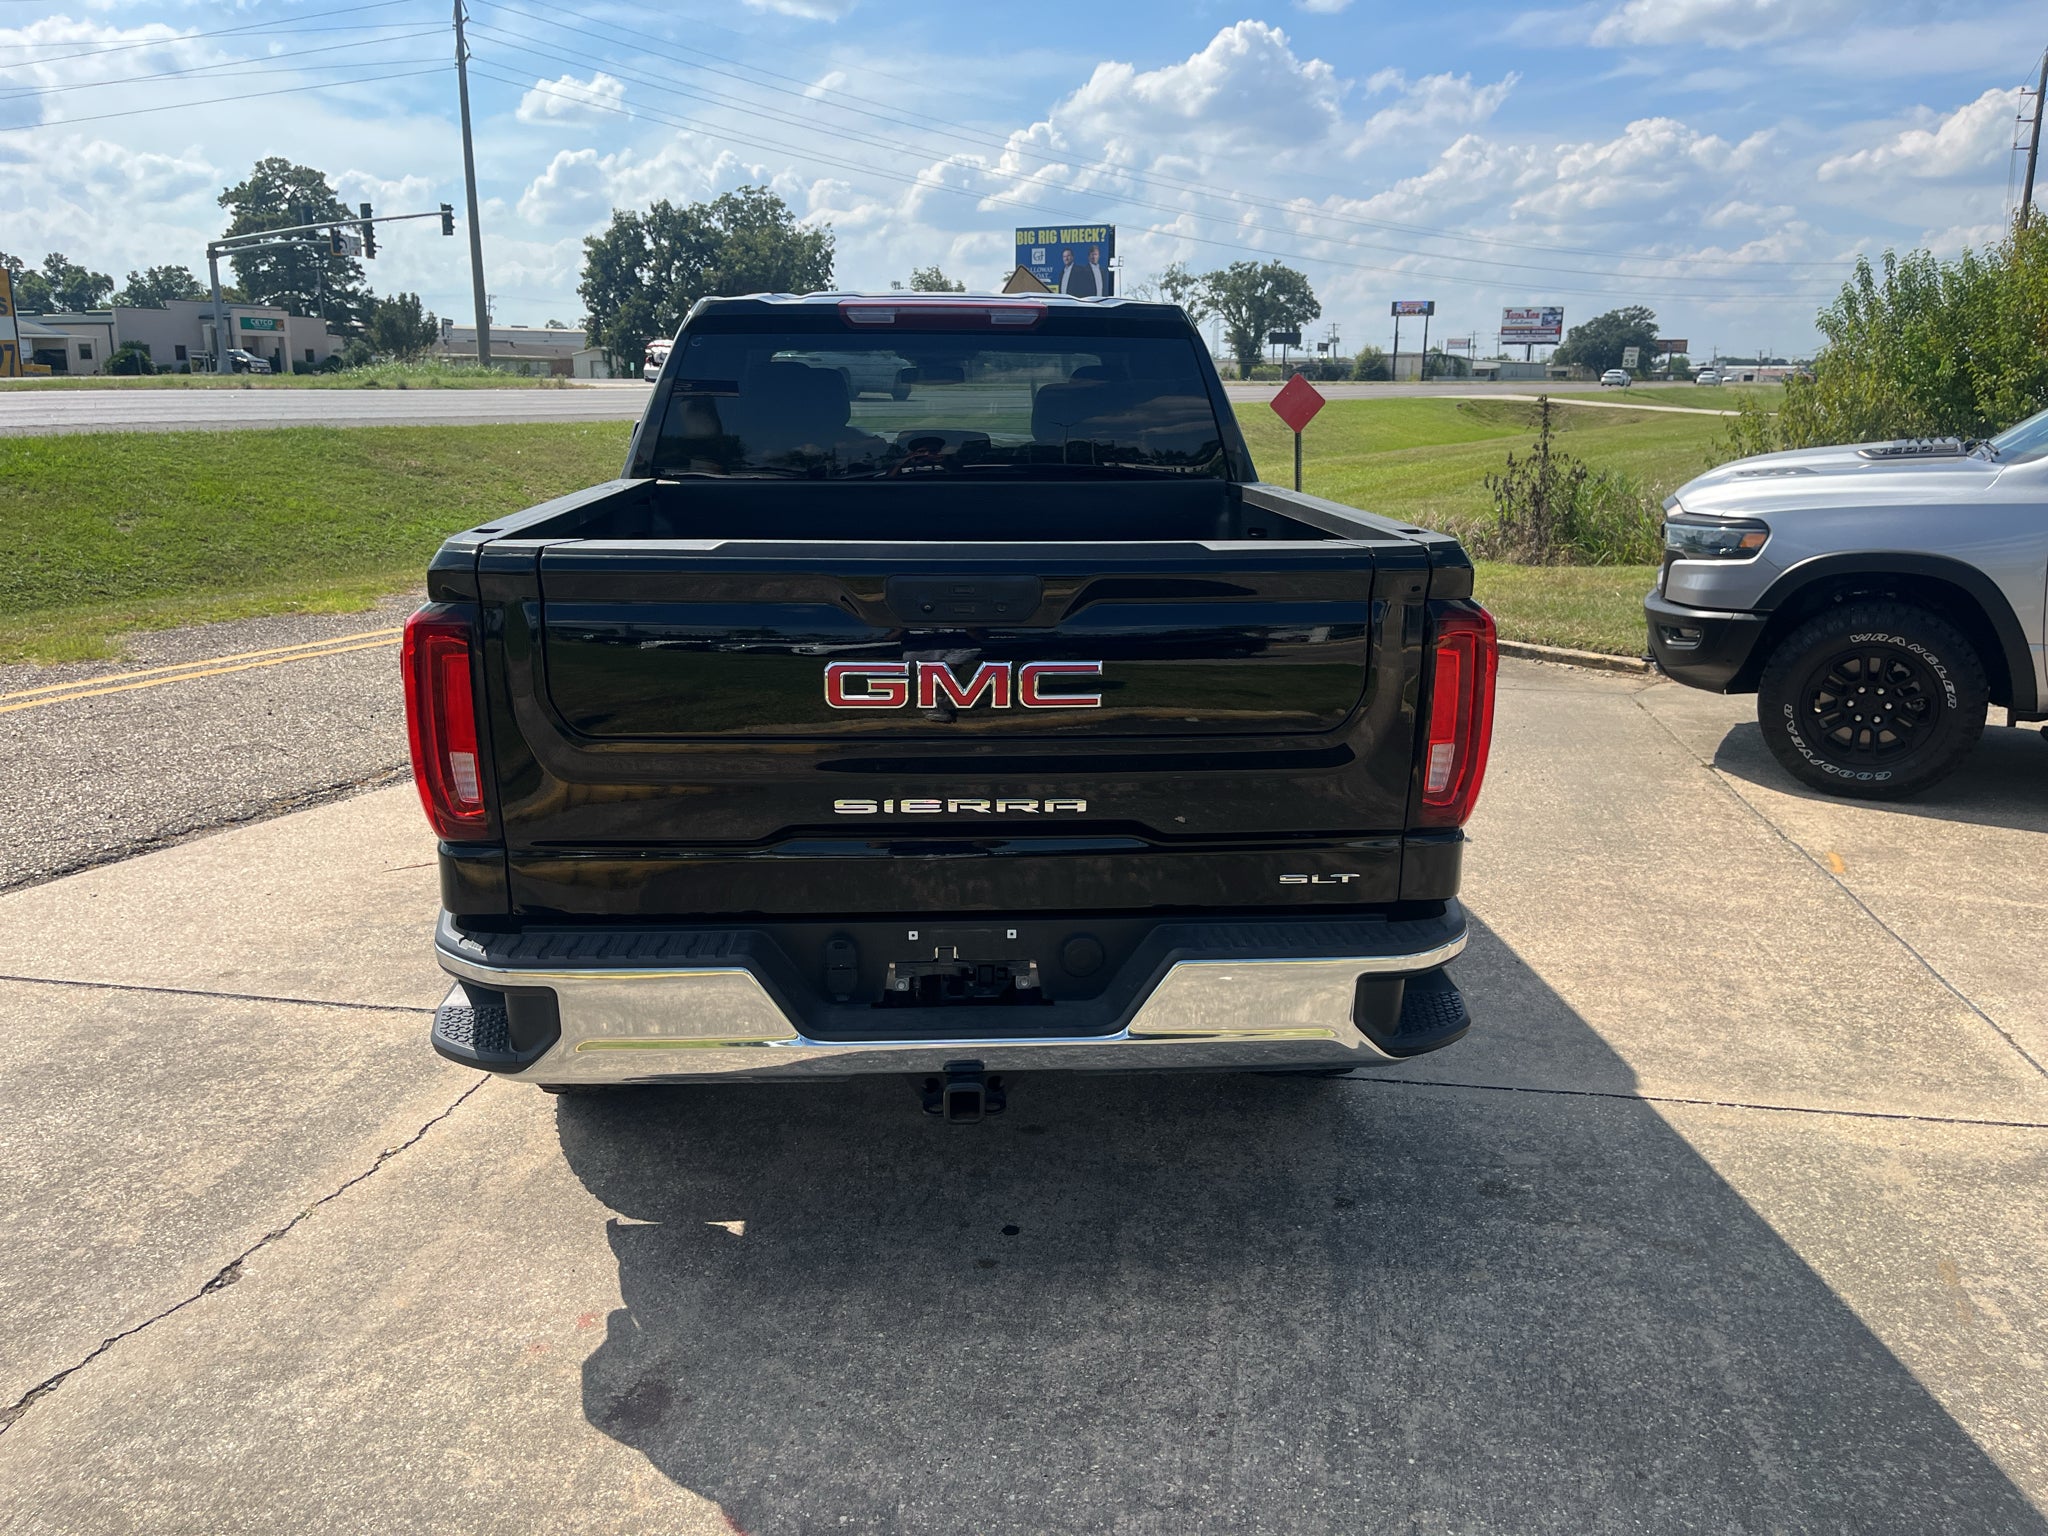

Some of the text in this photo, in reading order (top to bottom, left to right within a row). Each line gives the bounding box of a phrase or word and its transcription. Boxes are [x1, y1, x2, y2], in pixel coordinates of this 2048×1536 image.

[1016, 228, 1107, 245] BIG RIG WRECK?
[1624, 358, 1636, 366] 55
[1850, 633, 1957, 709] WRANGLER
[824, 661, 1103, 708] GMC
[1783, 703, 1892, 781] GOODYEAR
[834, 799, 1087, 814] SIERRA
[1279, 873, 1360, 884] SLT
